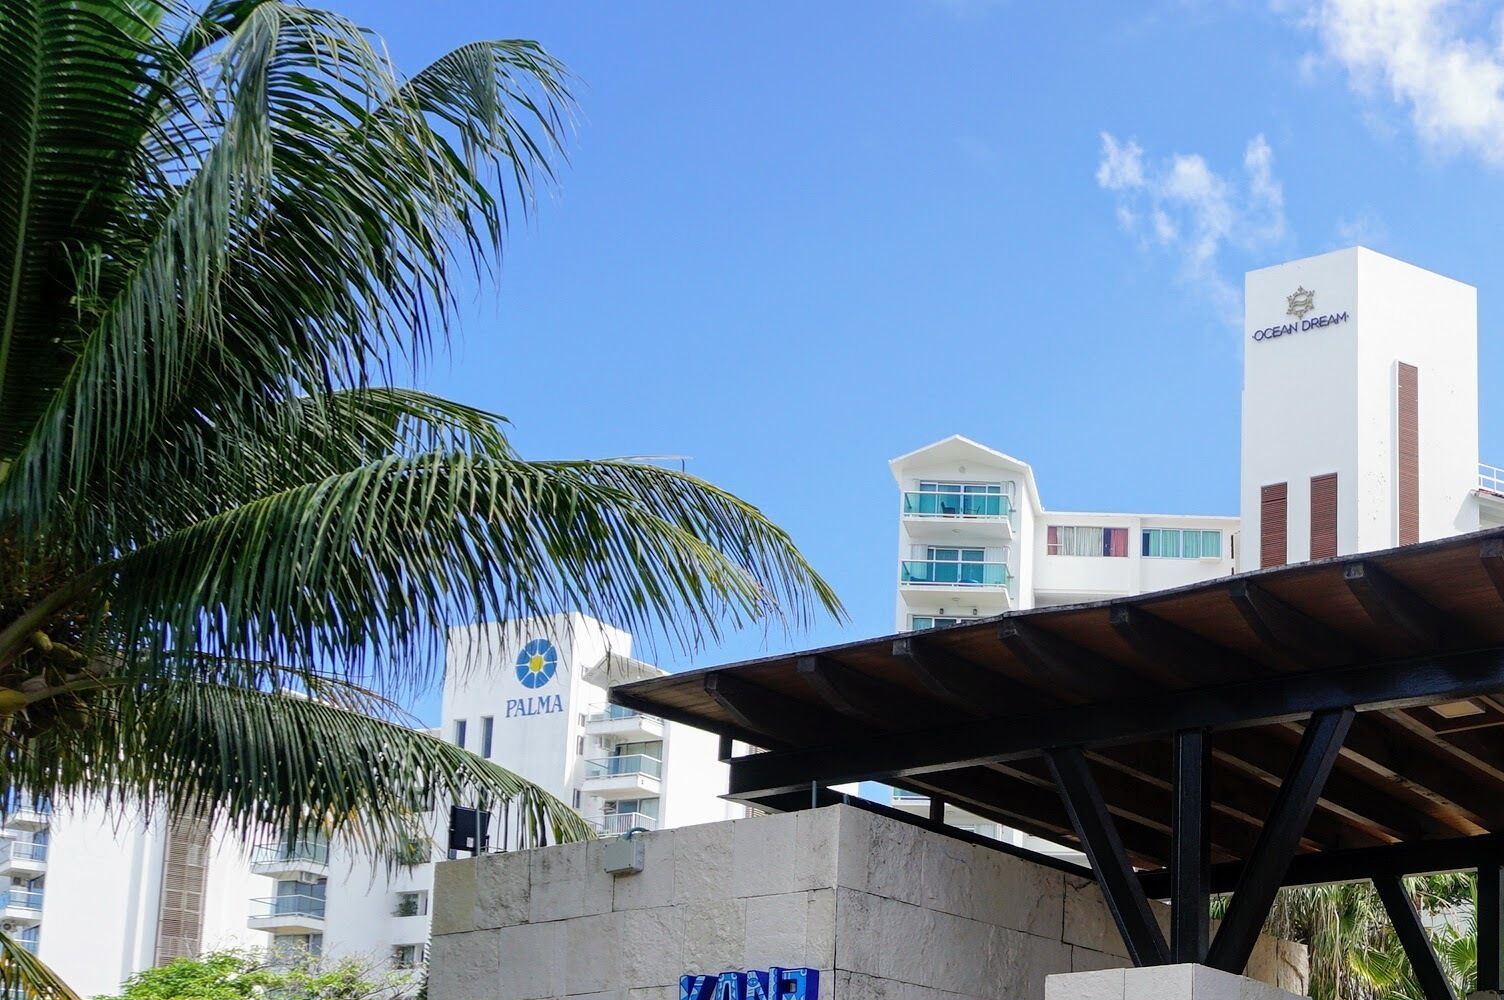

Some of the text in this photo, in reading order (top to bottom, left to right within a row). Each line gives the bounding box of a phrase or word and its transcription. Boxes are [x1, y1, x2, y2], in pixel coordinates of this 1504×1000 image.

[1254, 312, 1347, 341] OCEAN DREAM
[506, 694, 563, 718] PALMA
